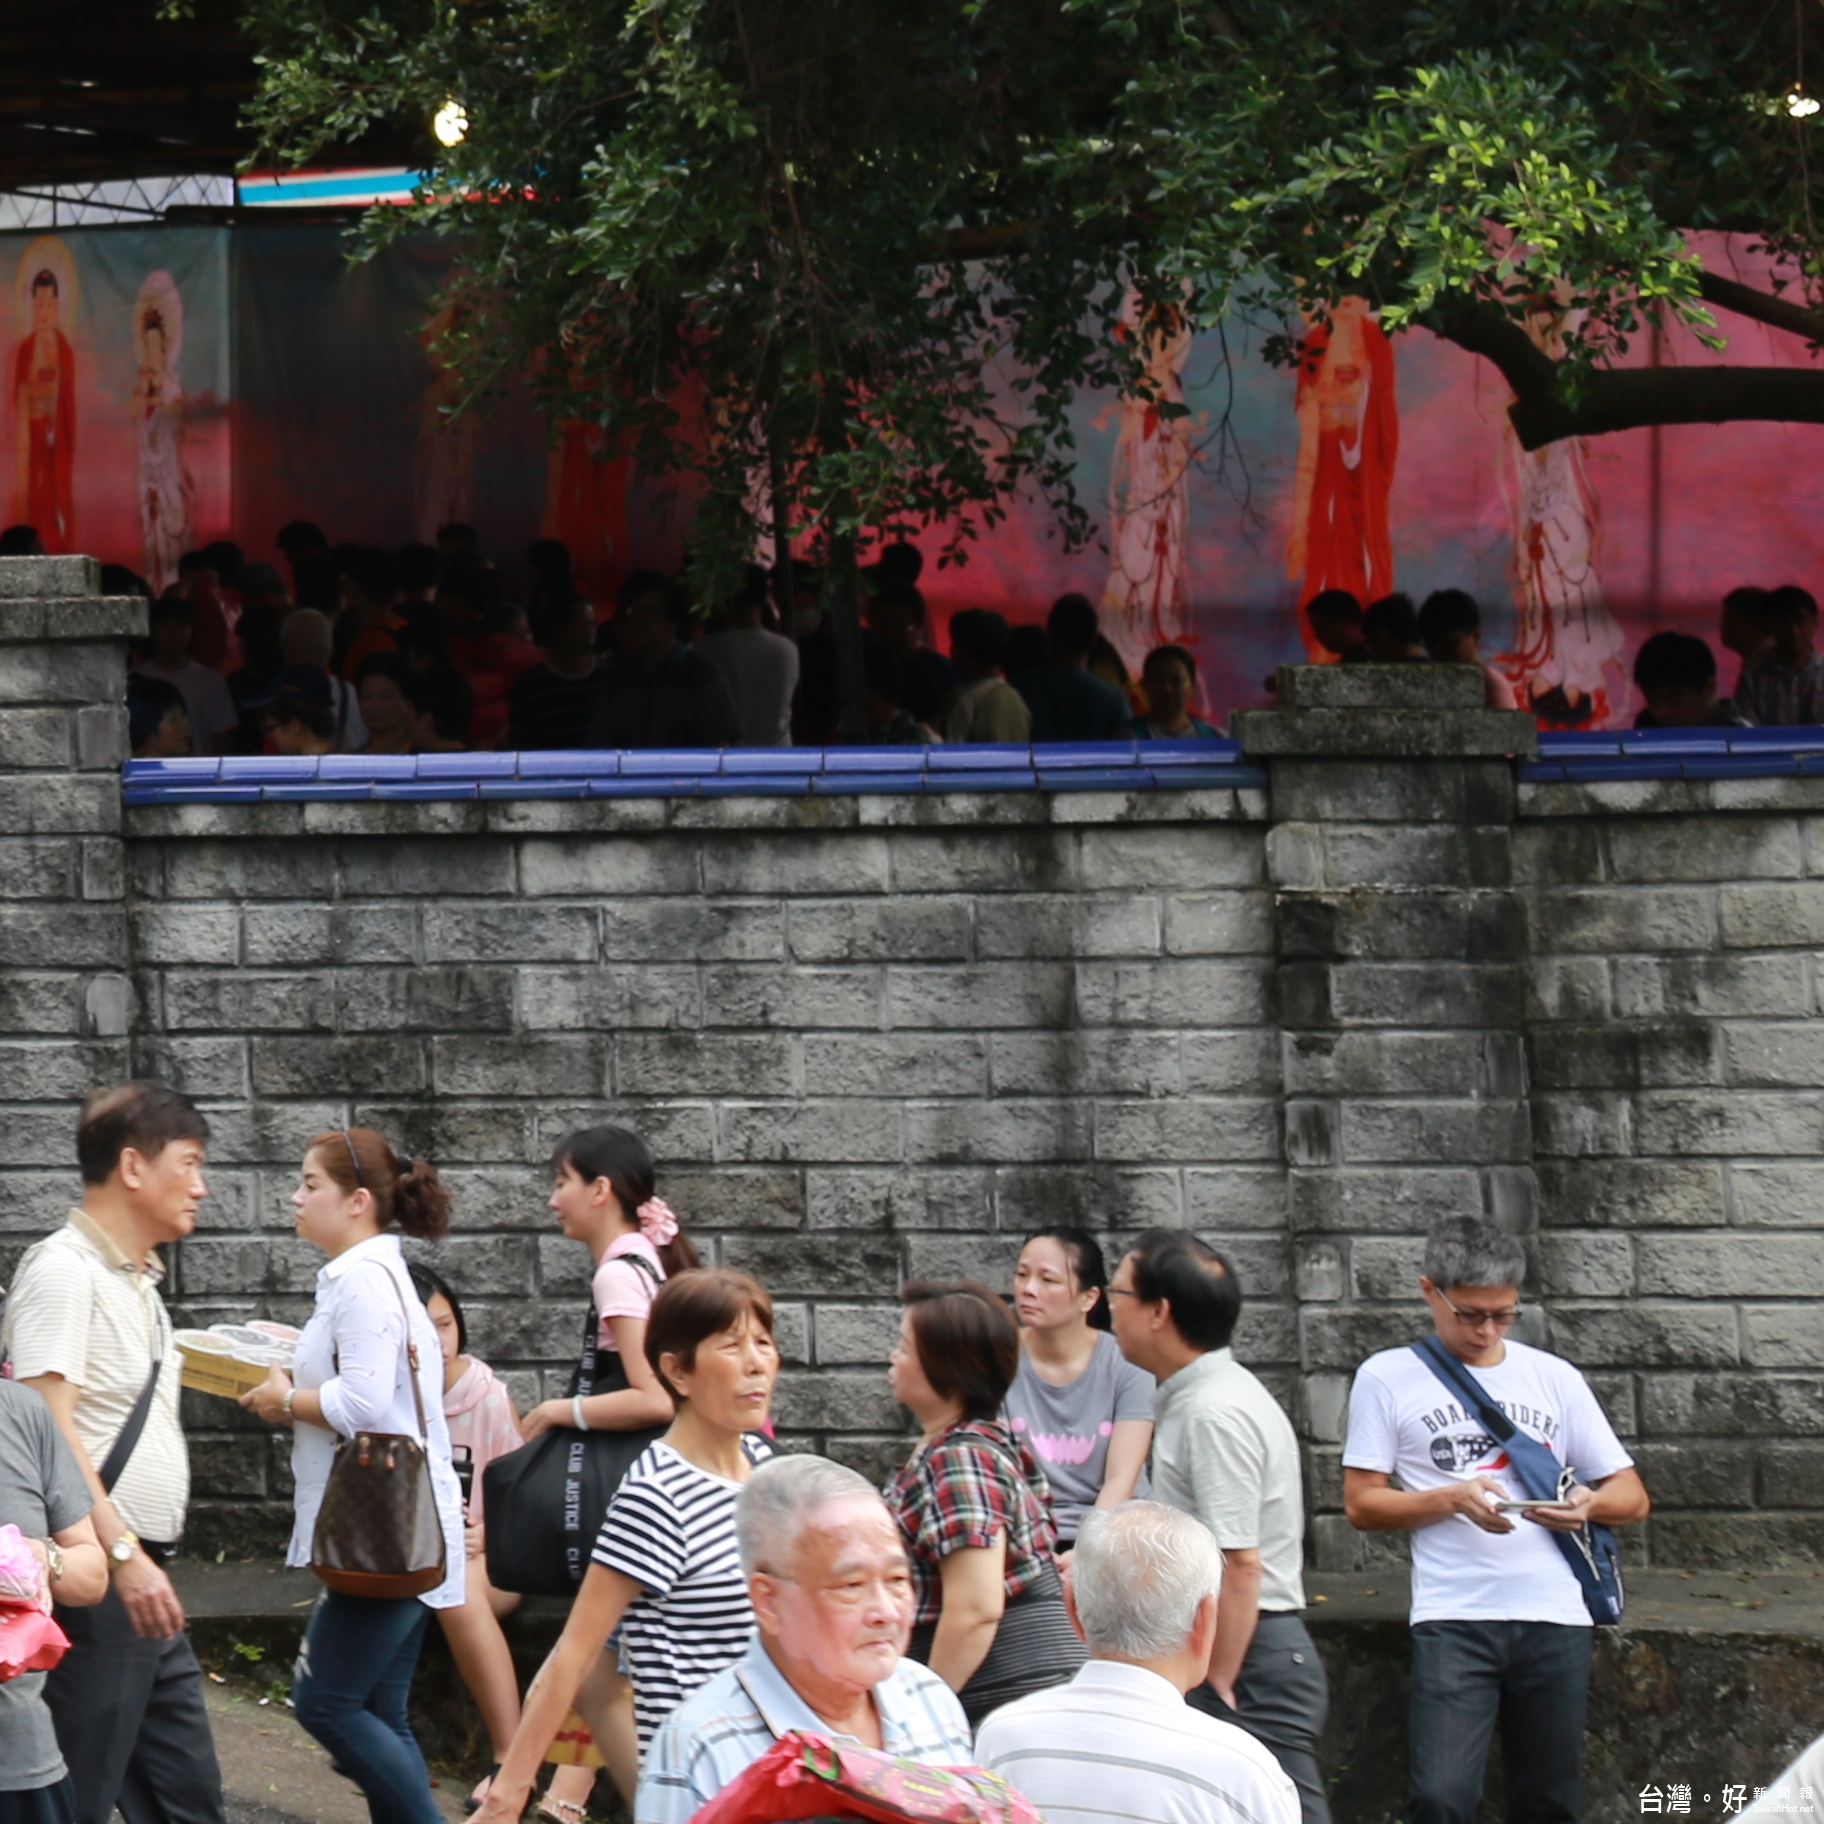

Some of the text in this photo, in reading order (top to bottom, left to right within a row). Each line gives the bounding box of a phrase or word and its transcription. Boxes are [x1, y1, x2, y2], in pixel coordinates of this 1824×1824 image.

[1420, 1402, 1473, 1434] BOA
[564, 1442, 585, 1531] CLUB JUSTICE
